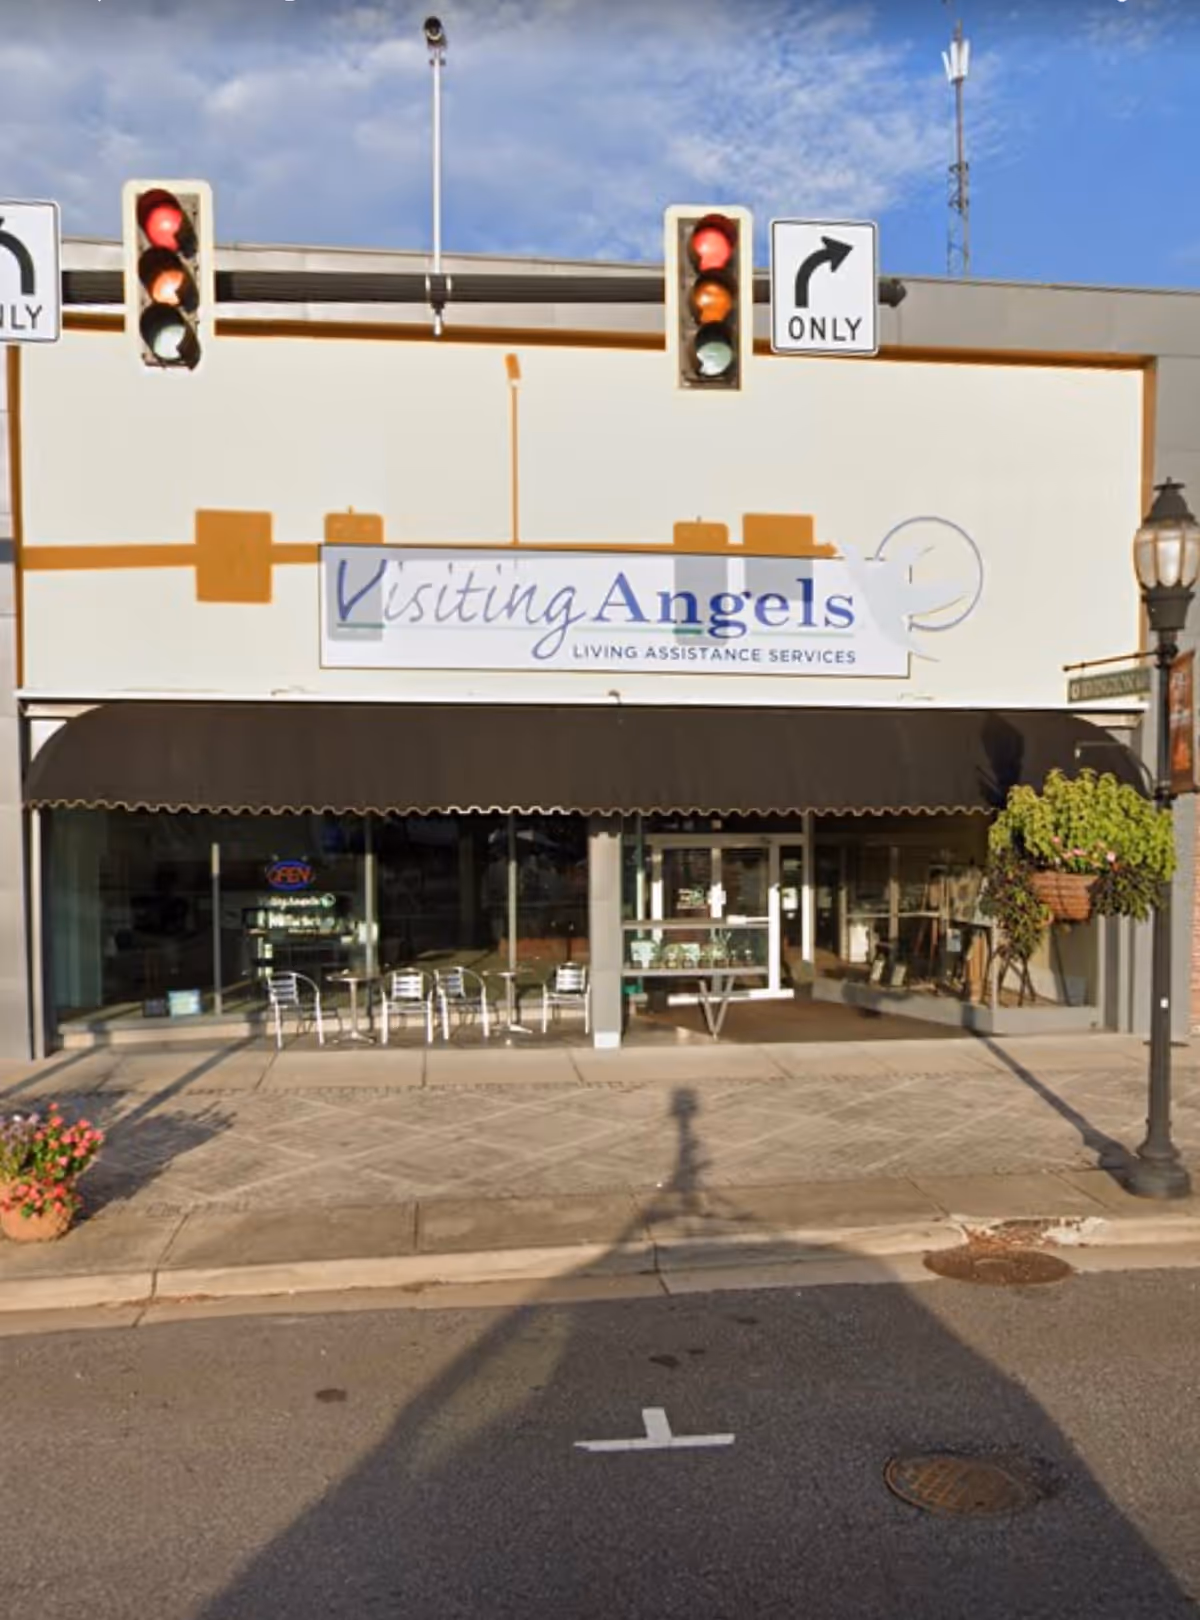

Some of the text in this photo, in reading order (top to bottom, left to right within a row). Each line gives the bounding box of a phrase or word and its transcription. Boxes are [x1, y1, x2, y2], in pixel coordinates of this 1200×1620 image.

[0, 304, 42, 330] LY
[788, 316, 862, 341] ONLY
[337, 559, 856, 660] Visiting Angels
[573, 645, 857, 664] LIVING ASSISTANCE SERVICES
